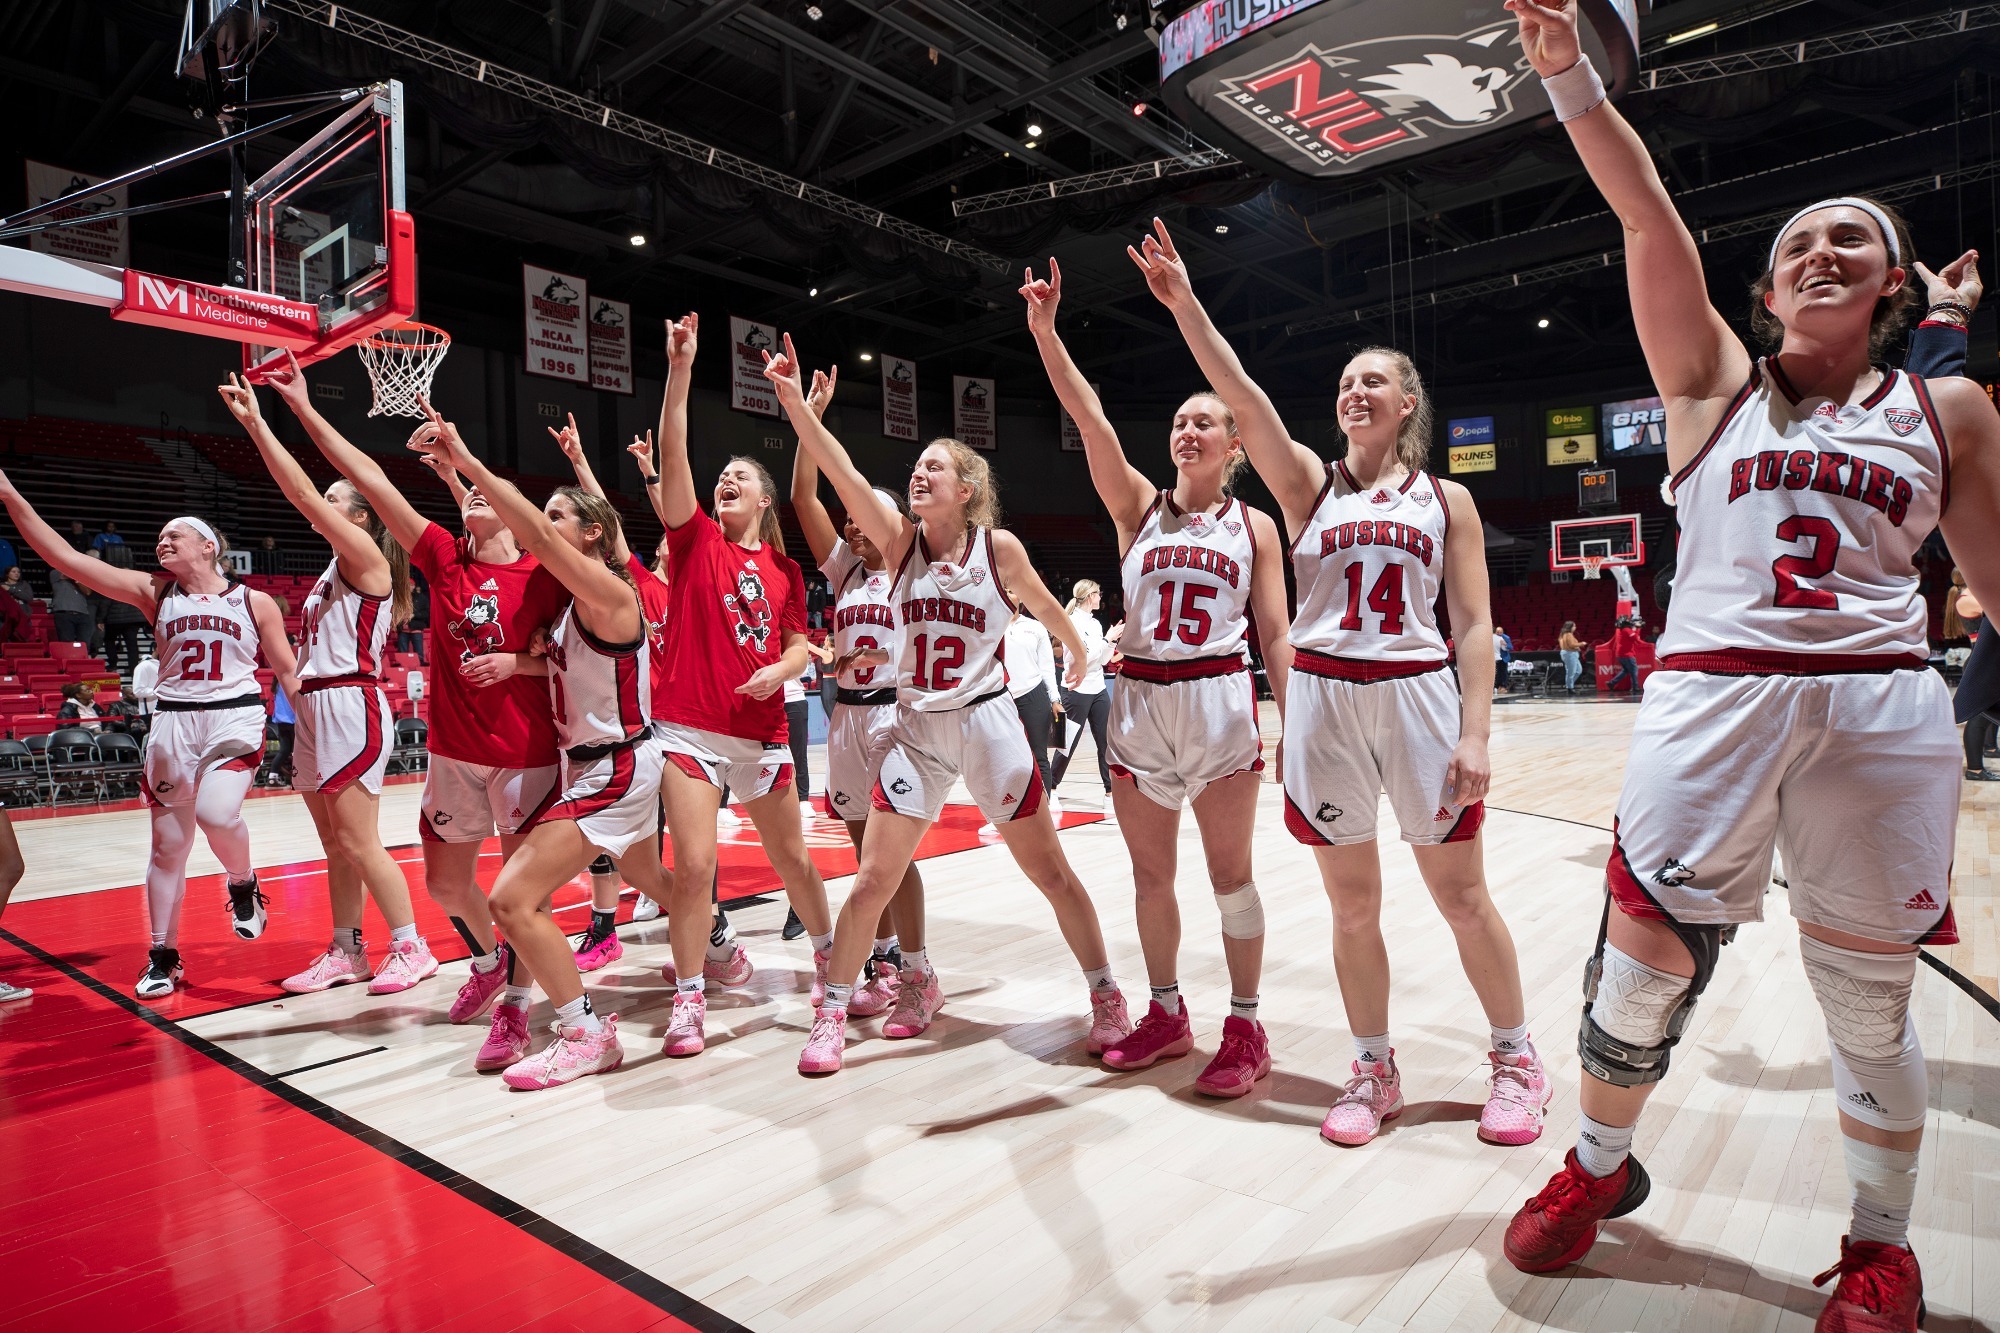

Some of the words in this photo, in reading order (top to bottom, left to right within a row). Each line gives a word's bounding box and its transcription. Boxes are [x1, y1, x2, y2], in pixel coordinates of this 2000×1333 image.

[1243, 57, 1407, 153] NIU
[1234, 92, 1333, 158] HUSKIES
[50, 240, 111, 258] CONFERENCE
[195, 287, 311, 321] Northwestern
[532, 295, 580, 320] NORTHERN
[195, 303, 268, 328] Medicine
[540, 309, 574, 322] ILLINOIS
[542, 328, 573, 345] NCAA
[529, 338, 585, 356] TOURNAMENT
[540, 357, 576, 375] 1996
[592, 373, 622, 388] 1994
[735, 381, 776, 395] CO-CHAMPIONS
[316, 385, 344, 396] SOUTH
[540, 404, 558, 416] 213
[741, 395, 770, 411] 2003
[885, 413, 917, 426] CHAMPIONS
[1612, 408, 1665, 427] GRE
[1887, 414, 1921, 424] MAC
[890, 423, 912, 437] 2006
[956, 427, 994, 436] CHAMPIONS
[1465, 426, 1490, 437] pepsi
[766, 438, 781, 449] 214
[964, 435, 987, 446] 2019
[1457, 450, 1494, 461] KUNES
[1728, 449, 1913, 528] HUSKIES
[1319, 520, 1434, 568] HUSKIES
[225, 555, 246, 570] 11
[1140, 545, 1240, 590] HUSKIES
[1772, 514, 1842, 611] 2
[1552, 571, 1568, 582] 116
[1339, 561, 1406, 636] 14
[836, 603, 895, 634] HUSKIE
[901, 597, 986, 634] HUSKIES
[1153, 580, 1219, 646] 15
[165, 614, 242, 641] HUSKIES
[179, 639, 224, 682] 21
[912, 633, 966, 691] 12
[1904, 901, 1940, 911] adidas
[1848, 1095, 1888, 1114] adidas
